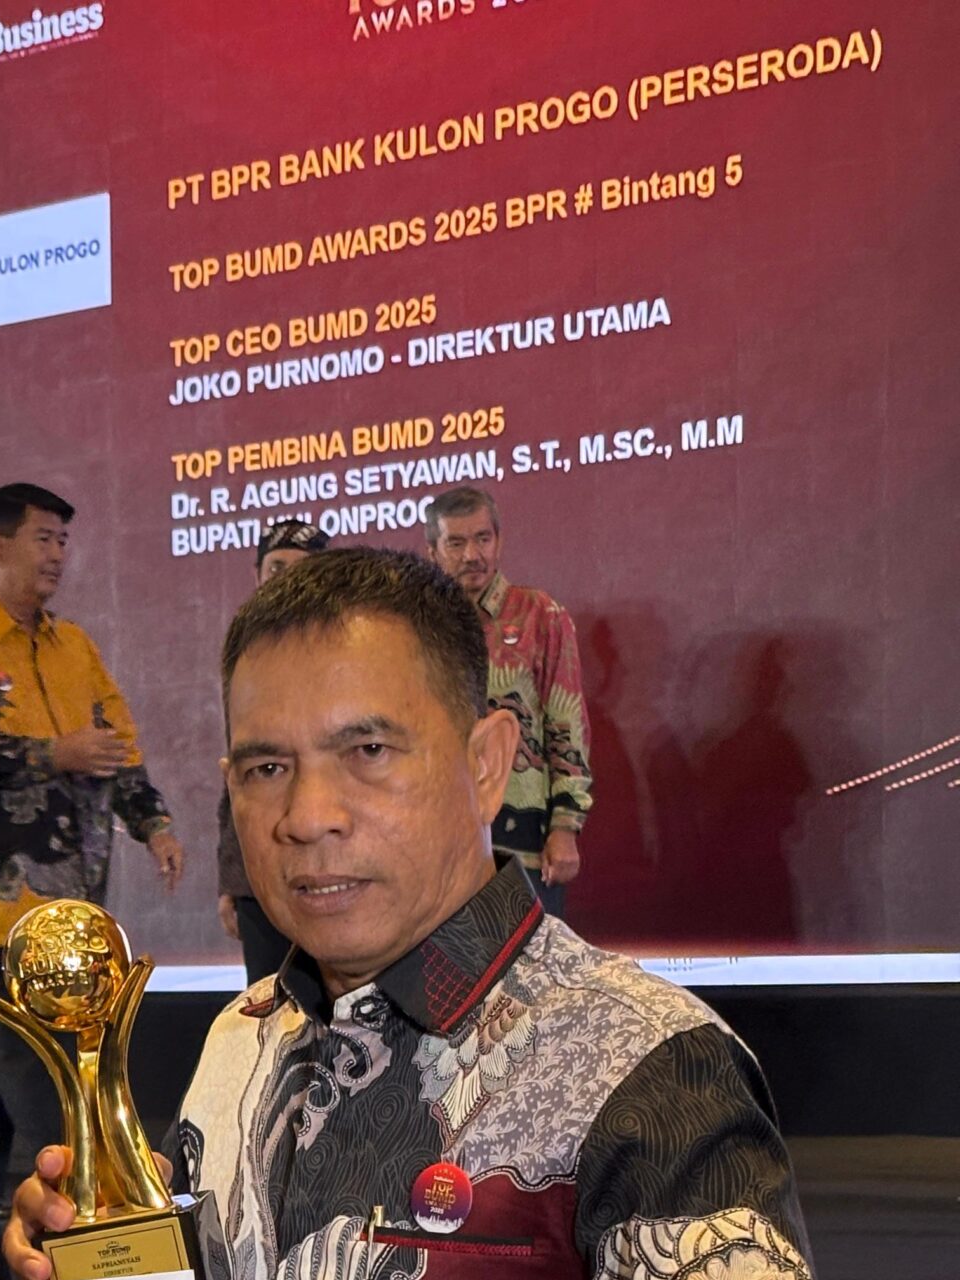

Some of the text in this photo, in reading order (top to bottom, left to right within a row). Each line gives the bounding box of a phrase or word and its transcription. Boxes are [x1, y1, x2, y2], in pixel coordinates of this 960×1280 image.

[168, 28, 882, 210] PT BPR BANK KULON PROGO (PERSERODA)
[45, 240, 100, 266] PROGO
[169, 154, 742, 292] TOP BUMD AWARDS 2025 BPR # Bintang 5
[168, 370, 240, 406] JOKO
[247, 346, 384, 393] PURNOMO
[408, 317, 555, 367] DIREKTUR
[563, 298, 671, 341] UTAMA
[170, 294, 436, 367] TOP CEO BUMD 2025
[171, 406, 505, 482] TOP PEMBINA BUMD 2025
[172, 414, 743, 520] Dr. R. AGUNG SETYAWAN, S.T., M.SC., M.M
[172, 519, 260, 556] BUPATI
